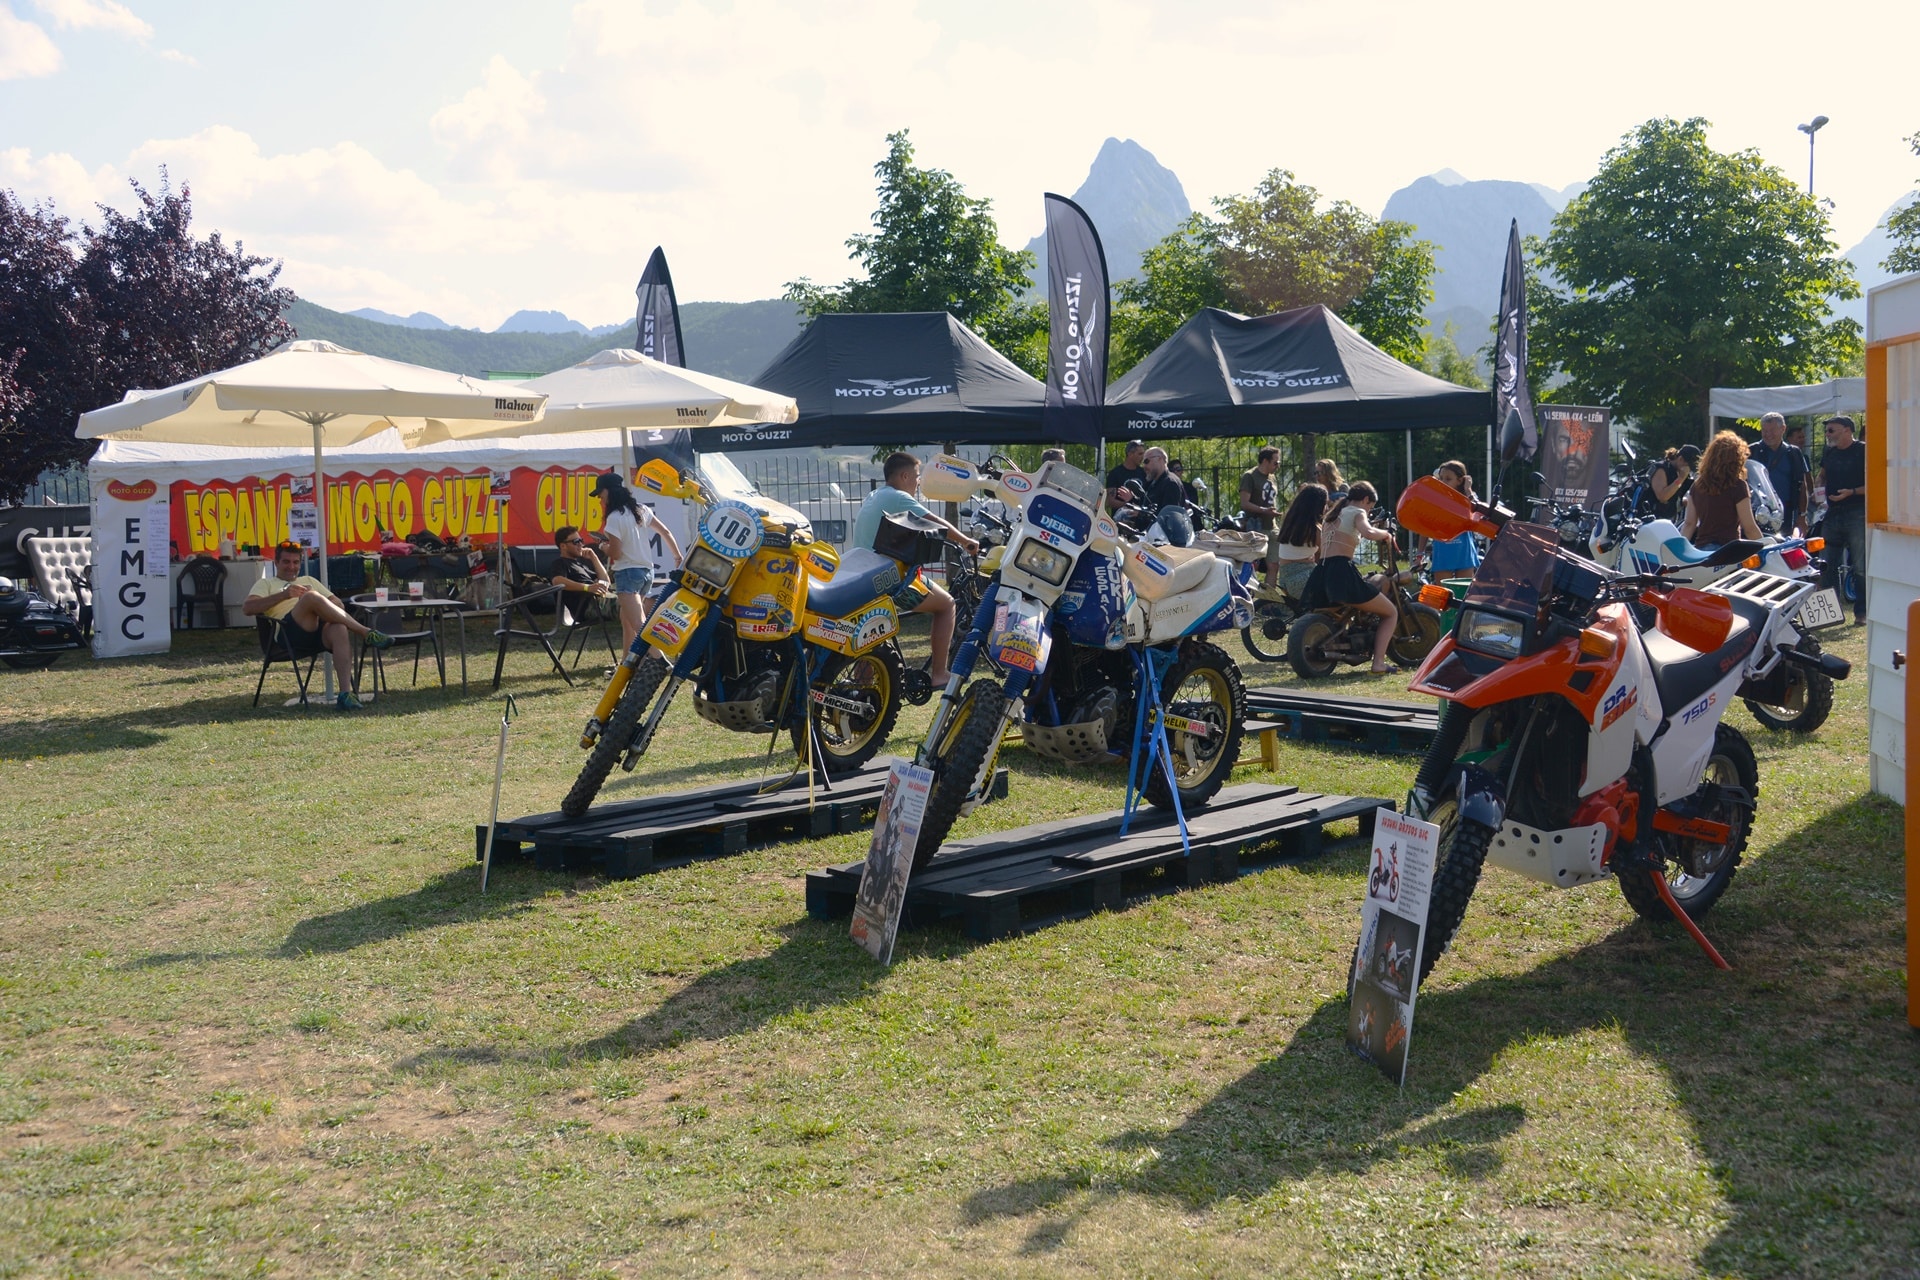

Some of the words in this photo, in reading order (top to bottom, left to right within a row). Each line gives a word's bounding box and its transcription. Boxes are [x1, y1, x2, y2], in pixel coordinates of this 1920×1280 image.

[1231, 376, 1278, 388] MOTO
[1287, 374, 1339, 388] GUZZI
[835, 389, 886, 398] MOTO
[892, 386, 948, 397] GUZZI
[494, 398, 534, 411] Mahou
[1128, 419, 1157, 429] MOTO
[1161, 419, 1193, 429] GUZZI
[722, 433, 753, 443] MOTO
[757, 431, 790, 440] GUZZI
[1007, 478, 1027, 489] ADA
[327, 478, 414, 544] MOTO
[536, 471, 604, 533] CLUB
[715, 515, 751, 547] 106
[1040, 515, 1076, 540] DJEBEL
[700, 525, 753, 557] TELEFUNKEN
[873, 566, 900, 593] 600
[661, 609, 689, 629] Castrol
[1807, 605, 1837, 624] 8715
[752, 624, 778, 633] IRIS
[835, 621, 856, 634] Castrol
[1223, 666, 1242, 719] MICHELIN
[1427, 682, 1452, 691] SUZUKI
[824, 696, 861, 713] MICHELIN
[1603, 685, 1627, 715] DR
[1682, 692, 1717, 725] 750S
